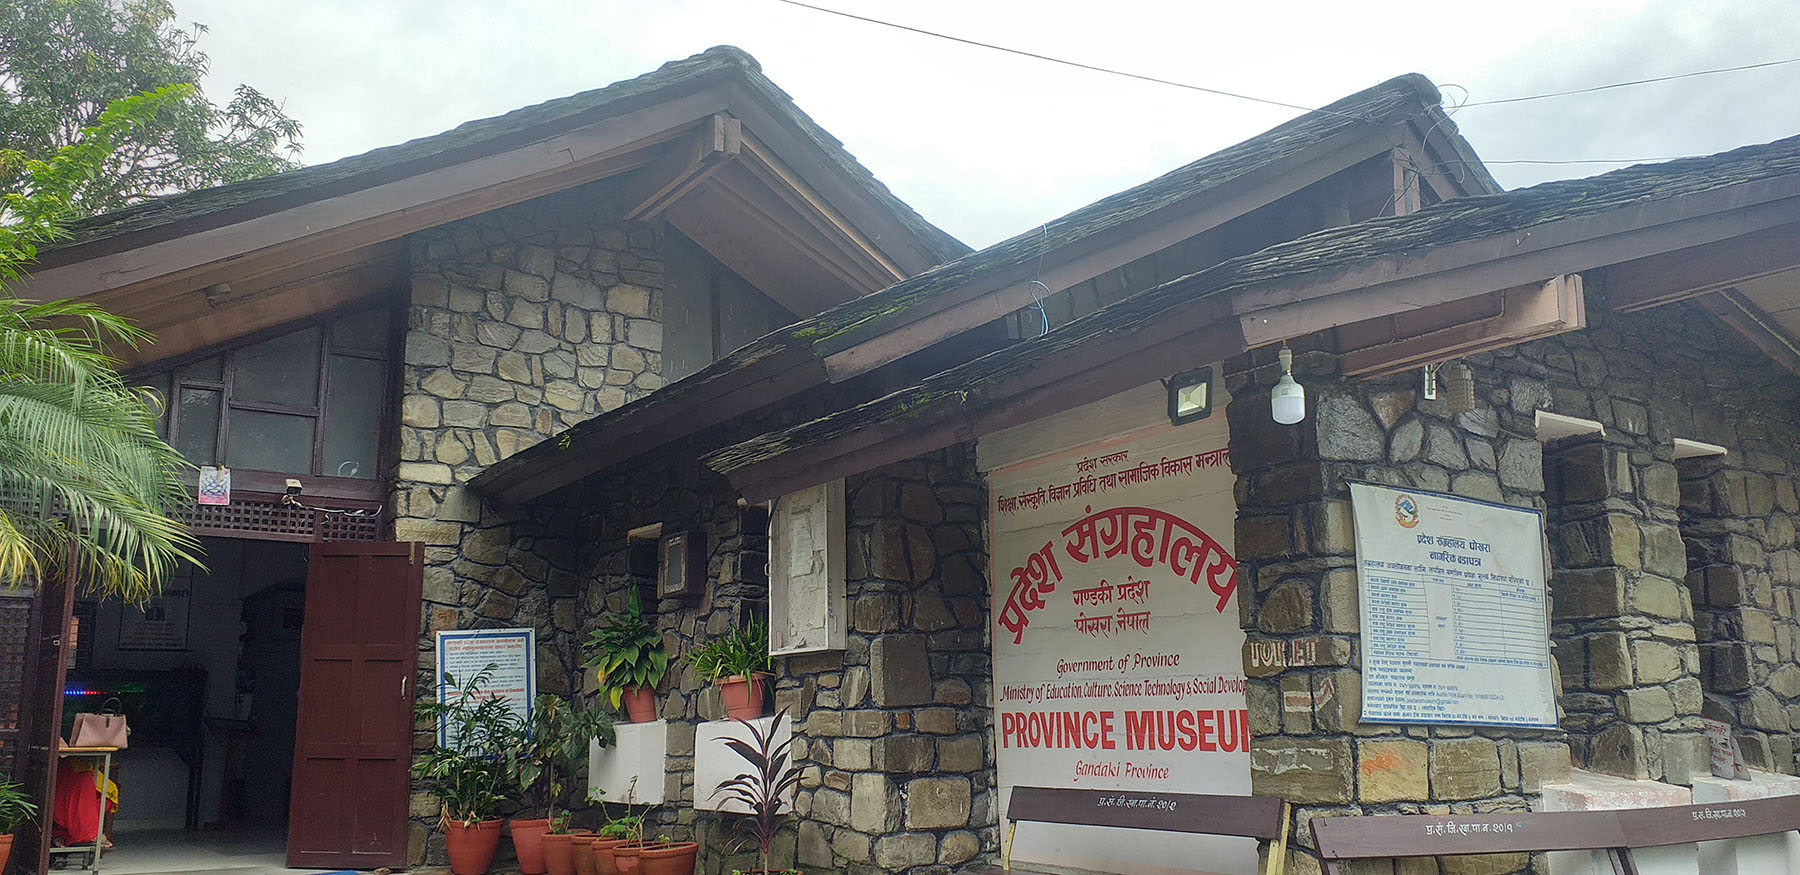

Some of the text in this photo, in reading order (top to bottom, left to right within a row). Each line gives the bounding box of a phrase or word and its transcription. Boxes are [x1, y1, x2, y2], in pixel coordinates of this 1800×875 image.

[1100, 450, 1129, 466] सरकार
[1099, 473, 1117, 494] तथा
[1118, 461, 1160, 489] सामाजिक
[1160, 456, 1193, 478] विकास
[998, 505, 1237, 645] प्रदेश संग्रहालय
[1072, 575, 1151, 607] गण्डकी प्रदेश
[1074, 611, 1113, 639] पोखरा
[1056, 652, 1180, 680] Government of Province
[999, 684, 1035, 705] Ministry
[1035, 683, 1046, 704] of
[1143, 678, 1187, 702] Technology
[1192, 675, 1217, 695] Social
[1001, 710, 1116, 750] PROVINCE
[1073, 759, 1169, 782] Gandaki Province
